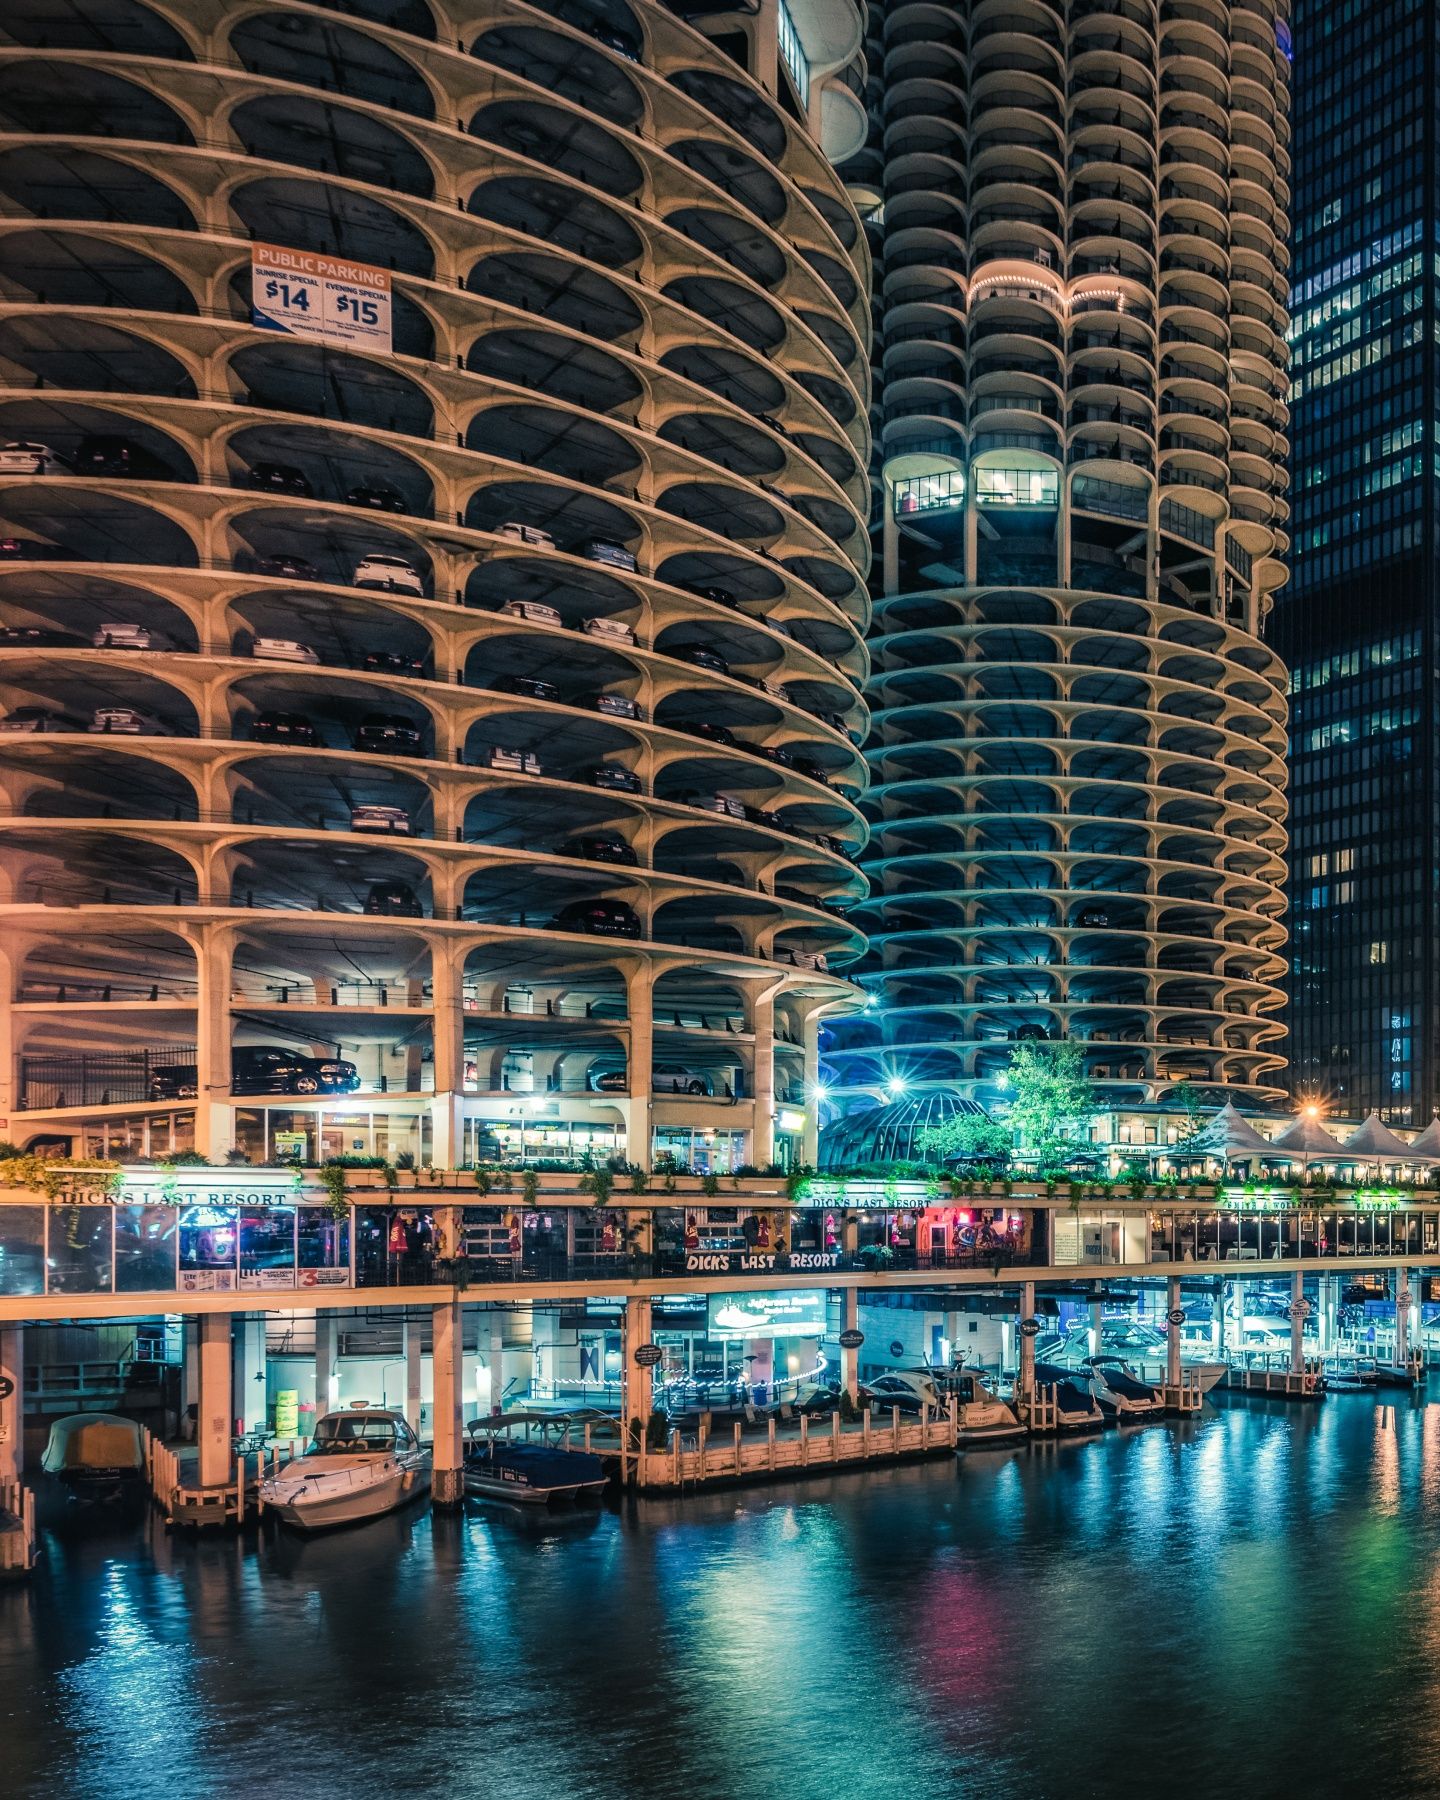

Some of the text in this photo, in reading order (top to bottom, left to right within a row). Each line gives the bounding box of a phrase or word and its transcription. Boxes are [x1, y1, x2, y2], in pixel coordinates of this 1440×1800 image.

[256, 268, 319, 286] SUNRISE SPECIAL
[259, 248, 385, 287] PUBLIC PARKING
[266, 280, 310, 311] $14
[325, 282, 388, 302] EVENING SPECIAL
[336, 295, 378, 326] $15
[62, 1192, 287, 1205] DICK'S LAST RESORT
[812, 1199, 850, 1208] DICK'S
[856, 1199, 883, 1208] LAST
[686, 1253, 838, 1270] DICK'S LAST RESORT
